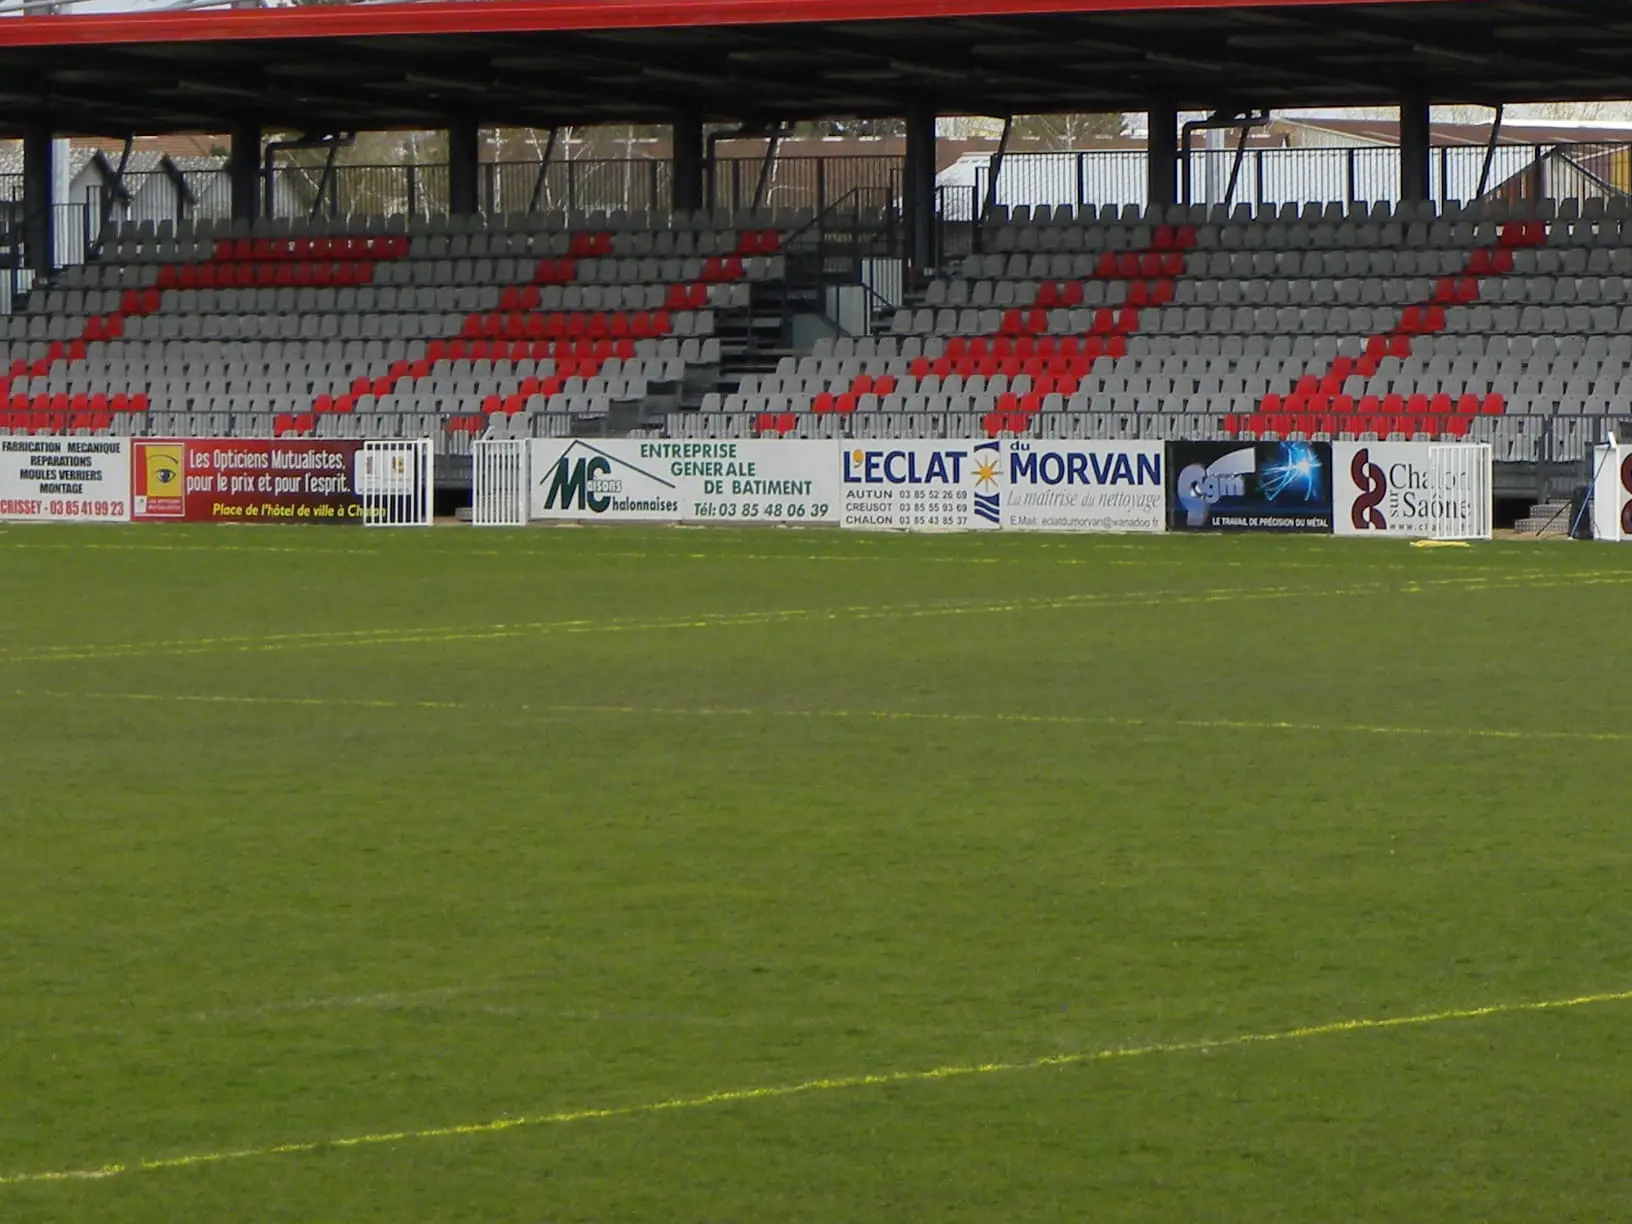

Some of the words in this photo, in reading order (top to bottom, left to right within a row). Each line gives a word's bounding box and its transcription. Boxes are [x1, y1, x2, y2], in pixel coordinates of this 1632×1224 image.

[2, 441, 60, 452] FABRICATION
[67, 442, 121, 454] MECANIQUE
[640, 443, 737, 458] ENTREPRISE
[1010, 440, 1031, 452] du
[30, 456, 92, 466] REPARATIONS
[189, 449, 210, 468] Les
[213, 449, 269, 471] Opticiens
[843, 448, 968, 484] L'ECLAT
[20, 469, 57, 480] MOULES
[59, 470, 103, 481] VERRIERS
[670, 462, 756, 477] GENERALE
[1010, 452, 1161, 486] MORVAN
[1389, 463, 1470, 490] Cha
[40, 483, 83, 494] MONTAGE
[187, 475, 213, 494] pour
[217, 473, 227, 491] le
[231, 473, 254, 495] prix
[258, 476, 273, 491] et
[275, 476, 302, 496] pour
[704, 480, 724, 495] DE
[732, 480, 813, 496] BATIMENT
[846, 489, 893, 499] AUTUN
[900, 490, 910, 499] 03
[914, 490, 925, 499] 85
[928, 490, 939, 499] 52
[942, 490, 953, 499] 26
[956, 490, 968, 500] 69
[1007, 490, 1022, 506] La
[1024, 489, 1078, 507] maîtrise
[1081, 492, 1095, 507] du
[1099, 492, 1161, 512] nettoyage
[0, 500, 42, 514] CRISSEY
[50, 500, 63, 515] 03
[65, 501, 79, 515] 85
[94, 501, 109, 516] 99
[111, 501, 124, 516] 23
[212, 503, 243, 516] Place
[245, 504, 258, 516] de
[297, 504, 310, 517] de
[313, 504, 334, 517] ville
[337, 504, 345, 517] à
[718, 503, 738, 517] 03
[741, 503, 759, 517] 85
[764, 503, 783, 517] 48
[787, 503, 806, 517] 06
[810, 503, 829, 518] 39
[846, 502, 893, 512] CREUSOT
[900, 503, 910, 512] 03
[914, 503, 925, 512] 85
[928, 503, 940, 512] 55
[956, 503, 968, 512] 69
[845, 515, 893, 525] CHALON
[900, 516, 910, 525] 03
[914, 516, 925, 525] 85
[928, 516, 939, 525] 43
[942, 516, 954, 525] 85
[956, 516, 968, 525] 37
[1212, 517, 1220, 526] LE
[1222, 517, 1248, 526] TRAVAIL
[1249, 517, 1258, 526] DE
[1296, 518, 1305, 527] DU
